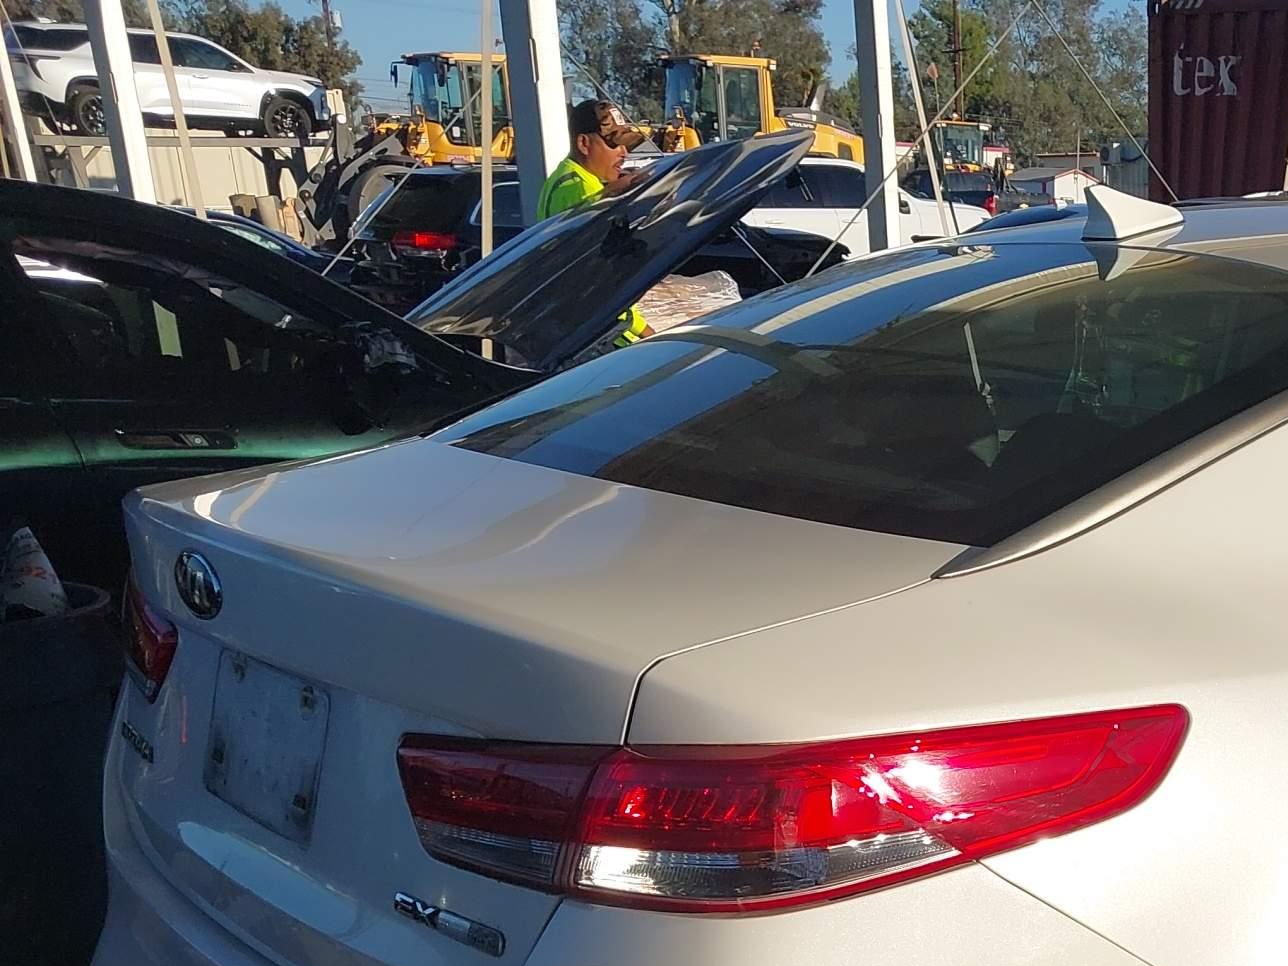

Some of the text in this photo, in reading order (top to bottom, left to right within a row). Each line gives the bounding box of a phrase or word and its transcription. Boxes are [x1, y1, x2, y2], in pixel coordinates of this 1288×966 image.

[1173, 42, 1242, 97] tex
[787, 121, 815, 129] VOLVO
[394, 892, 438, 929] EX
